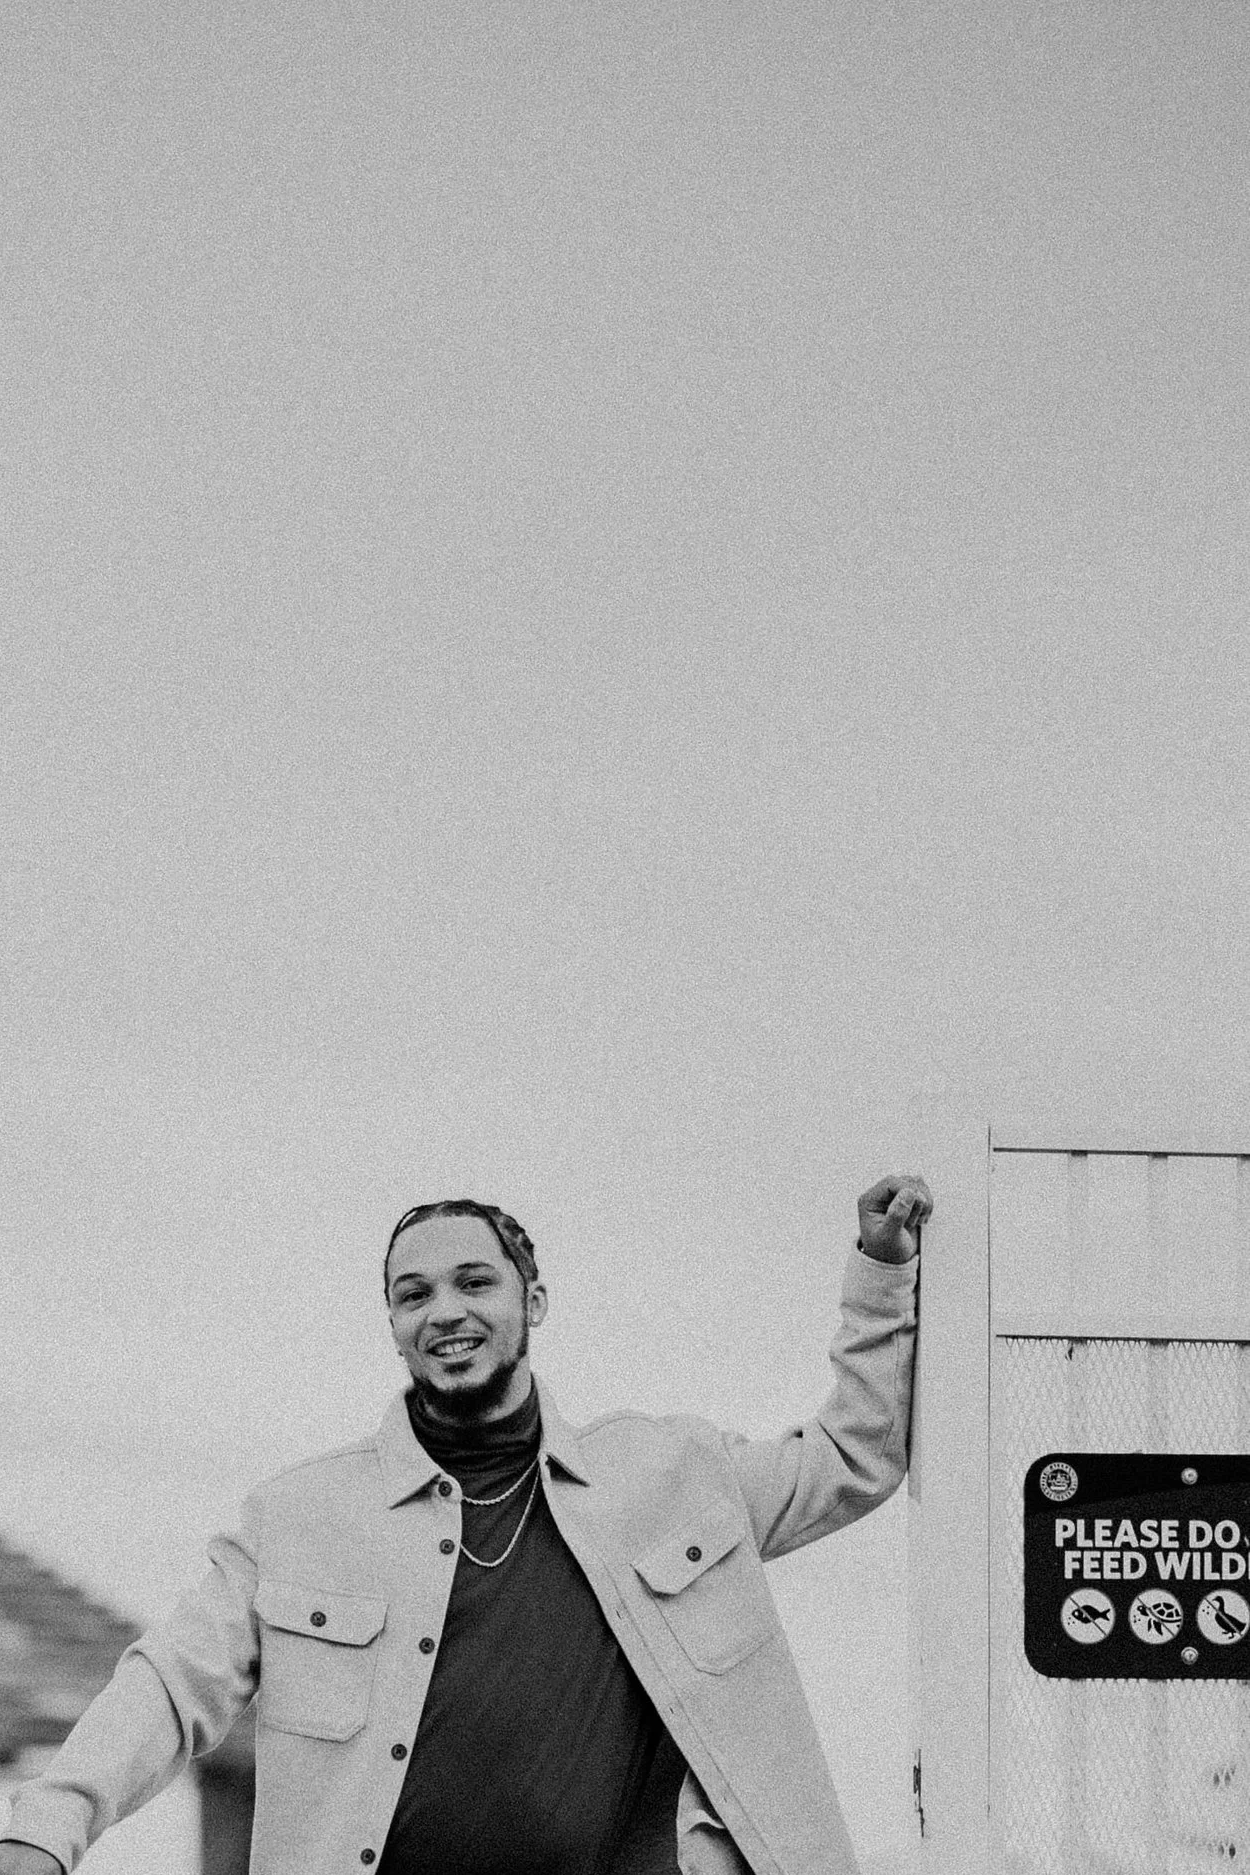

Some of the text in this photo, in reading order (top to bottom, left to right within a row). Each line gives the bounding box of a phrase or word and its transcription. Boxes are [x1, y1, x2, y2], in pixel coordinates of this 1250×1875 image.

[1054, 1518, 1241, 1549] PLEASE DO
[1064, 1550, 1250, 1581] FEED WILD
